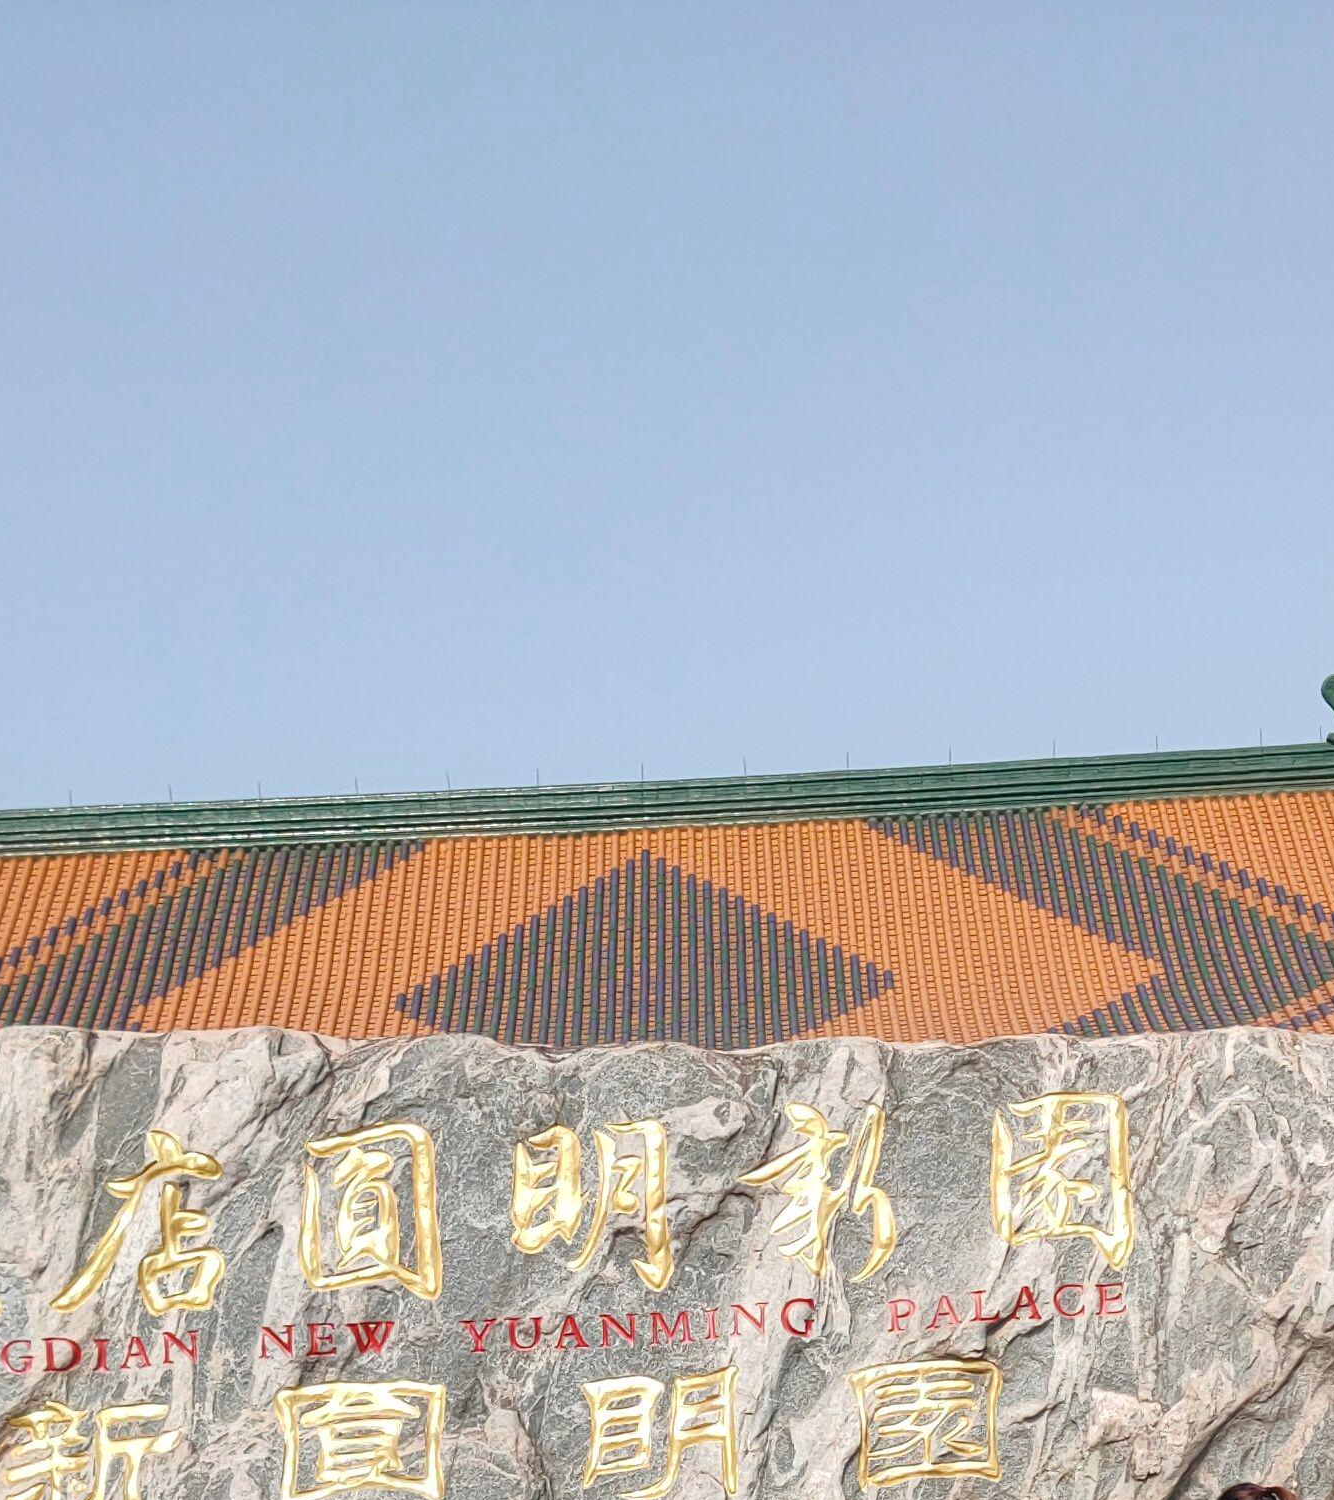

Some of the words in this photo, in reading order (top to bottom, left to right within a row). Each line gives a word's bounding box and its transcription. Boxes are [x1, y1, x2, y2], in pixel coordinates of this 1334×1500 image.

[259, 1319, 397, 1361] NEW
[461, 1297, 817, 1354] YUANMING
[887, 1282, 1127, 1333] PALACE
